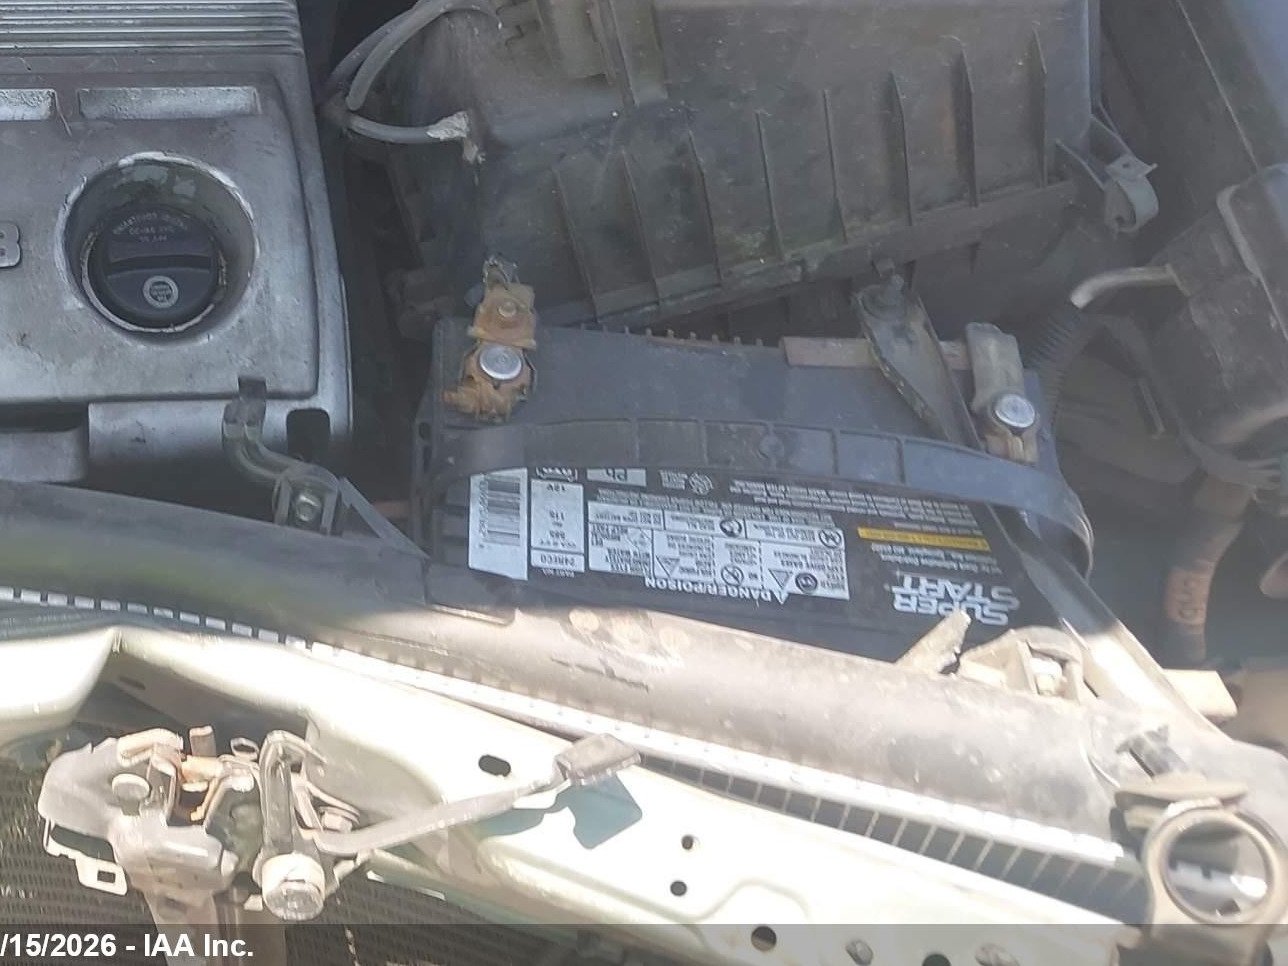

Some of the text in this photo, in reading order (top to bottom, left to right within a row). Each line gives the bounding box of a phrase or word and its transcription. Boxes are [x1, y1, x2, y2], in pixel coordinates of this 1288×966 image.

[645, 577, 774, 602] DANGER/POISON
[892, 574, 1020, 610] START
[892, 593, 1009, 626] SUPER
